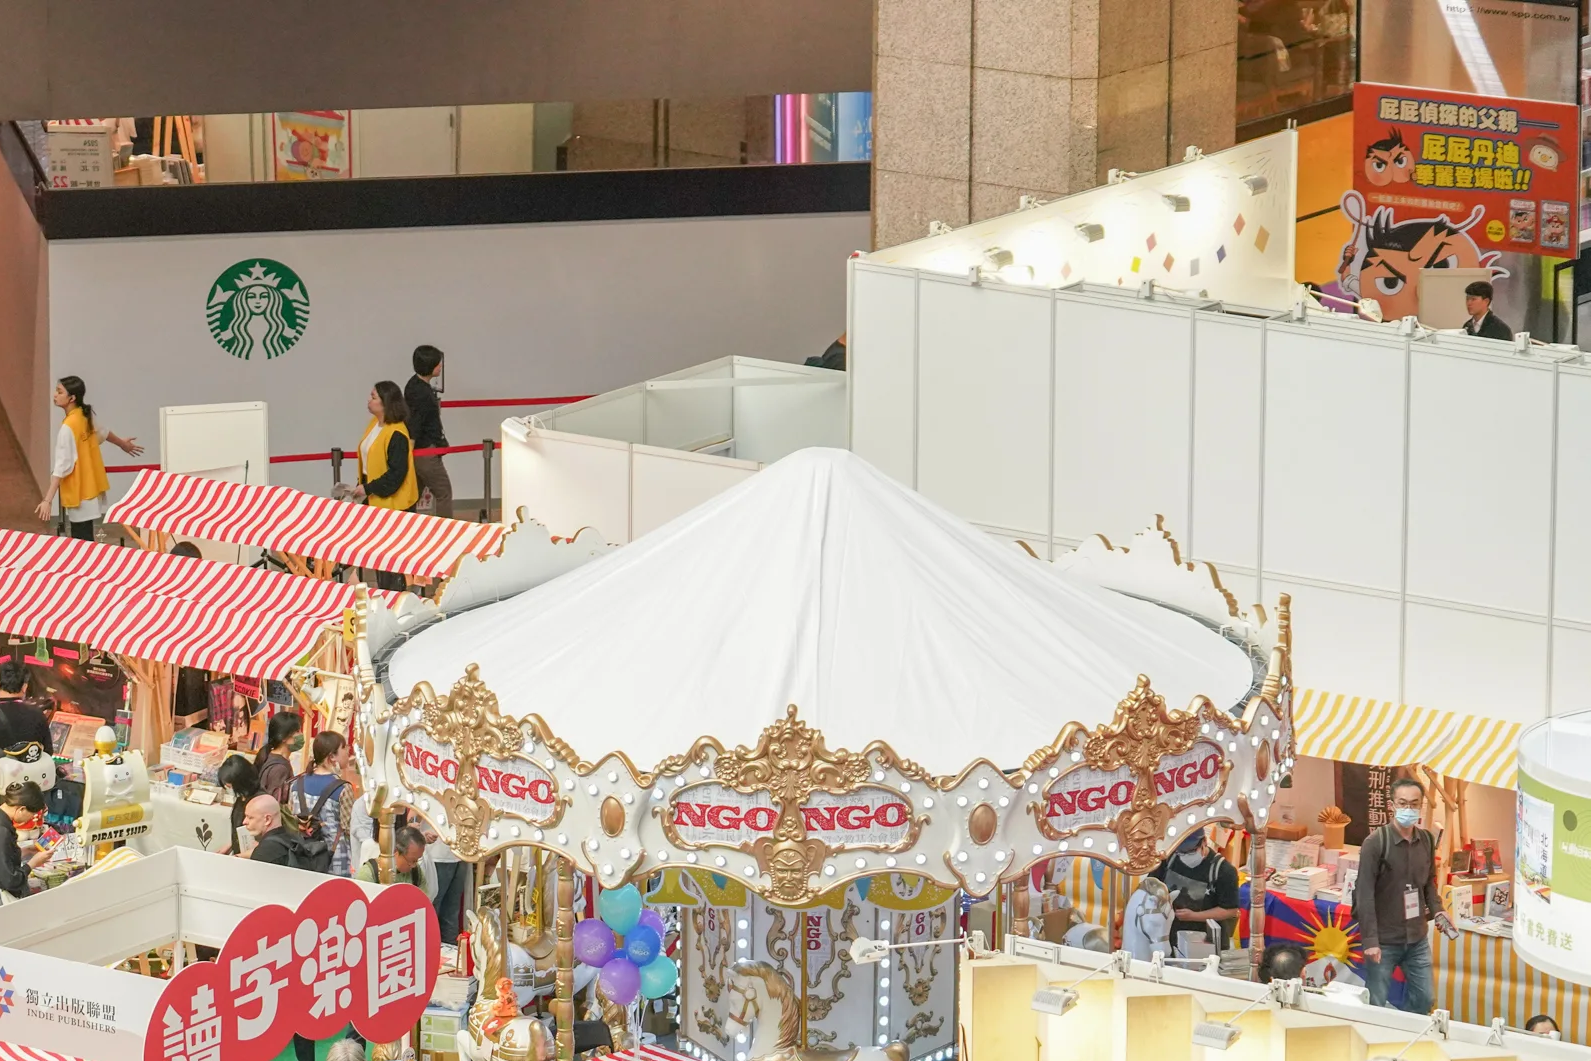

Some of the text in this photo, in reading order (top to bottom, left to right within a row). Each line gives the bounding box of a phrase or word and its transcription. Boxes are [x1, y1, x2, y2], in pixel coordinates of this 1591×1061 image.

[1379, 97, 1519, 134] 屁屁偵探的父親
[1421, 133, 1521, 169] 屁屁丹迪
[1415, 165, 1532, 192] 華麗登場啦!!
[404, 740, 460, 785] NGO
[1153, 753, 1220, 797] NGO
[475, 765, 556, 805] NGO
[1045, 780, 1138, 818] NGO
[673, 801, 779, 832] NGO
[800, 802, 910, 832] NGO
[91, 825, 148, 843] PIRATE SHIP
[708, 907, 716, 932] GO
[806, 915, 823, 951] NGO
[915, 912, 926, 936] GO
[26, 988, 116, 1022] 獨立出版聯盟
[27, 1008, 116, 1034] INDIE PUBLISHERS
